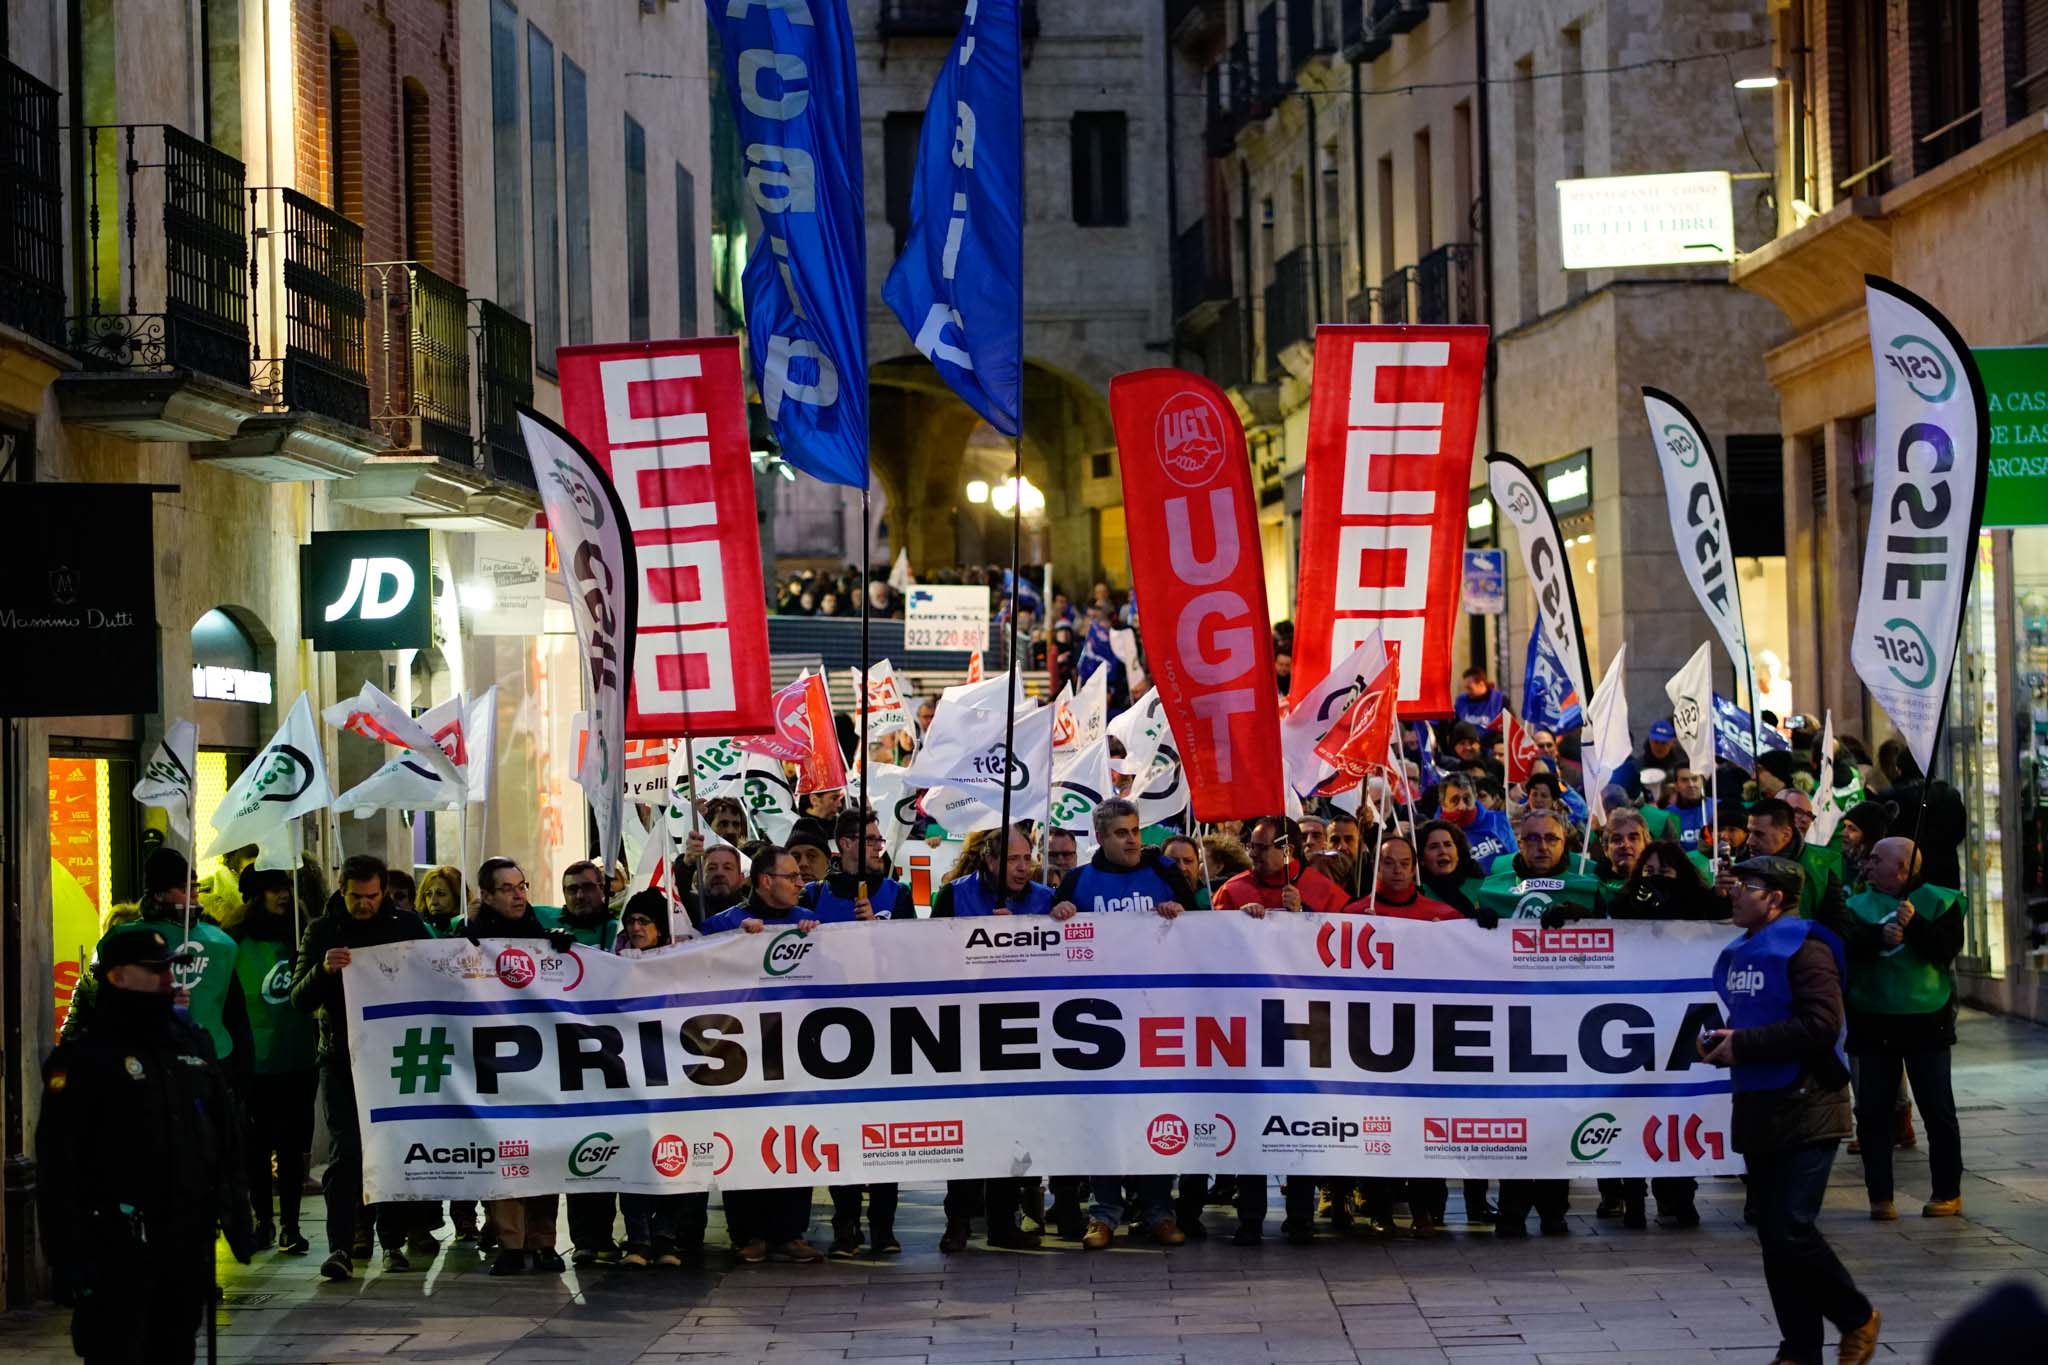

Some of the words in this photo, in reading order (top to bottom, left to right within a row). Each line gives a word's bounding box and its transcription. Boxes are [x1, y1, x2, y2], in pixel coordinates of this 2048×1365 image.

[2007, 391, 2048, 412] CAS
[1164, 406, 1212, 444] UGT
[1331, 342, 1450, 701] CCOO
[599, 354, 736, 714] CCOO
[325, 557, 415, 621] JD
[0, 608, 80, 631] Massimo
[87, 608, 136, 629] Dutti
[909, 629, 930, 646] 923
[935, 629, 958, 646] 220
[1164, 487, 1256, 785] UGT
[68, 856, 94, 866] FILA
[1093, 892, 1154, 912] Acaip
[965, 926, 1061, 951] Acaip
[1066, 928, 1092, 939] EPSU
[1544, 932, 1610, 949] CCOO
[772, 943, 813, 961] CSIF
[1066, 949, 1094, 960] USO
[1559, 954, 1567, 962] la
[1569, 954, 1614, 962] ciudadanía
[500, 955, 530, 972] UGT
[540, 959, 563, 971] ESP
[893, 1125, 959, 1144] CCOO
[1153, 1120, 1184, 1137] UGT
[1194, 1123, 1216, 1135] ESP
[1261, 1116, 1359, 1142] Acaip
[1365, 1122, 1389, 1132] EPSU
[1456, 1122, 1523, 1139] CCOO
[1580, 1127, 1622, 1145] CSIF
[404, 1142, 496, 1168] Acaip
[501, 1146, 526, 1157] EPSU
[577, 1145, 619, 1163] CSIF
[656, 1142, 683, 1159] UGT
[693, 1142, 714, 1155] ESP
[863, 1150, 899, 1159] servicios
[908, 1149, 916, 1157] la
[918, 1147, 963, 1156] ciudadanía
[1424, 1144, 1461, 1152] servicios
